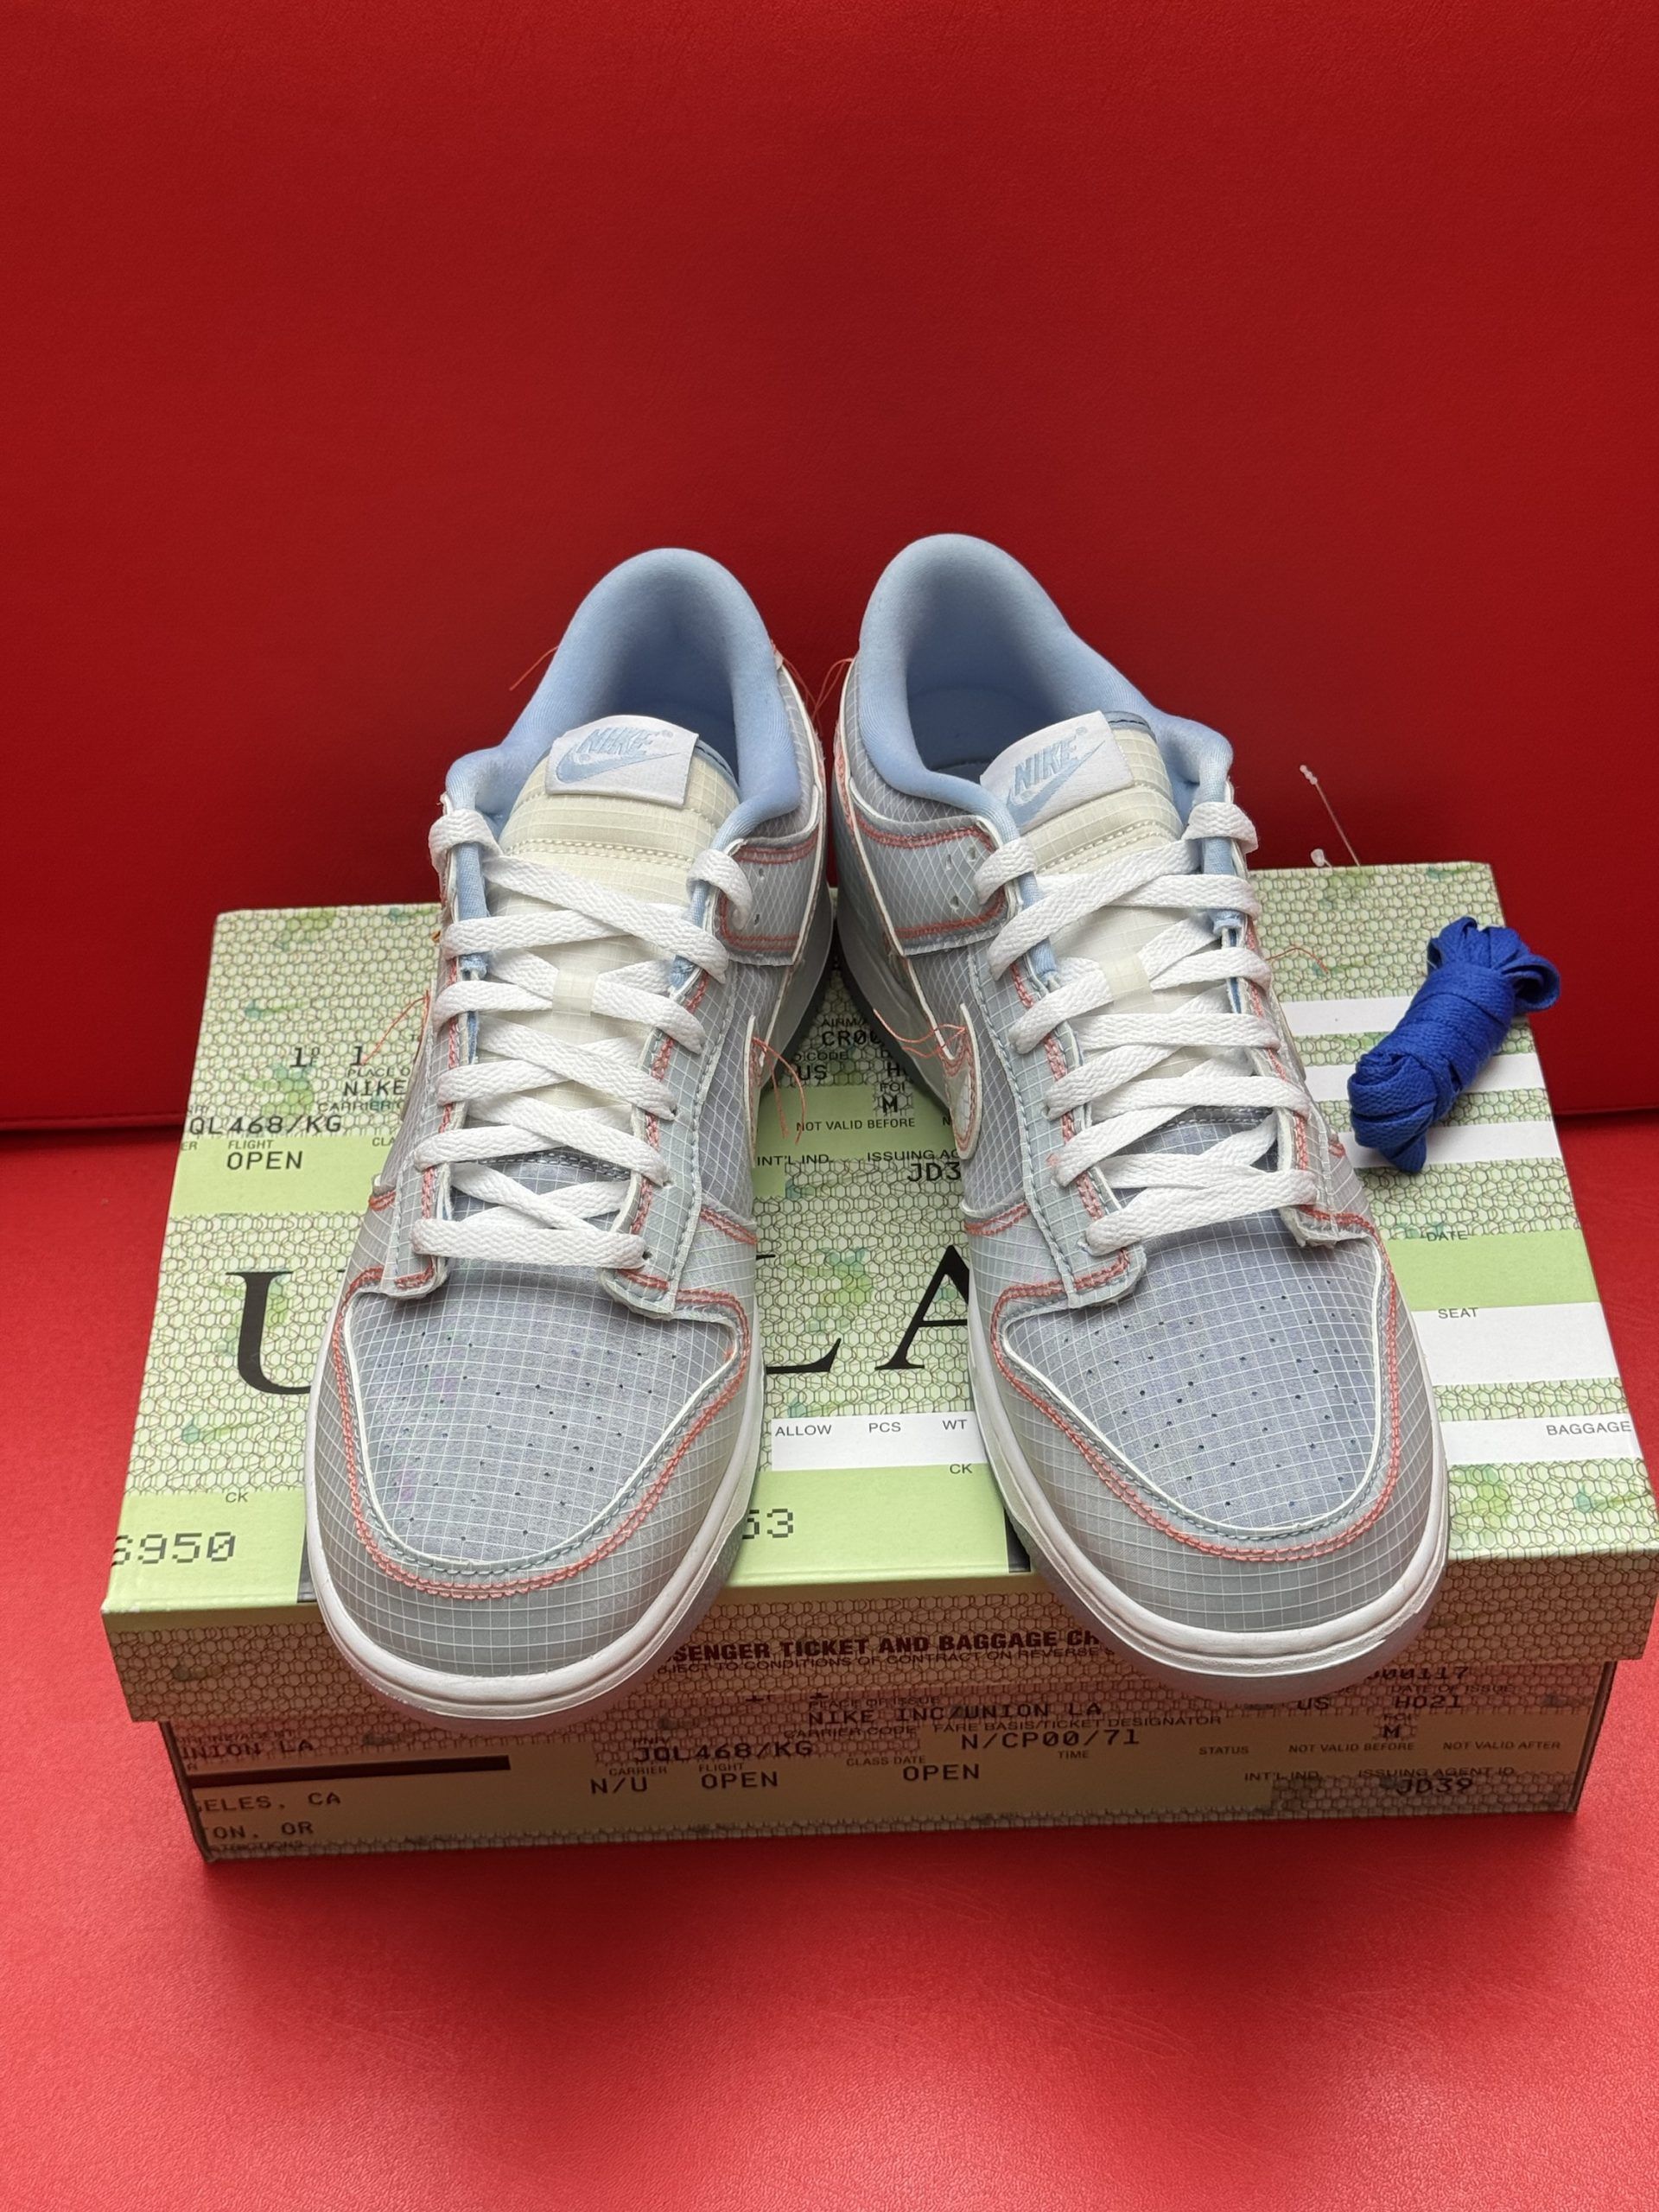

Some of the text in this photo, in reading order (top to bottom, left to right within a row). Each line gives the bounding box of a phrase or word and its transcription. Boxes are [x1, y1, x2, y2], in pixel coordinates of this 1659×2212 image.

[575, 727, 659, 754] NIKE
[1014, 734, 1077, 796] NIKE
[347, 1068, 396, 1077] PLACE
[798, 1065, 827, 1081] US
[345, 1079, 405, 1096] NIKE
[317, 1101, 391, 1112] CARRIER
[882, 1095, 898, 1113] M
[796, 1117, 916, 1131] NOT VALID BEFORE
[228, 1140, 273, 1149] FLIGHT
[226, 1150, 302, 1170] OPEN
[757, 1154, 796, 1166] INT'L
[867, 1149, 935, 1163] ISSUING
[1427, 1230, 1469, 1242] DATE
[1438, 1307, 1479, 1319] SEAT
[775, 1419, 968, 1437] ALLOW PCS WT
[1546, 1421, 1632, 1436] BAGGAGE
[950, 1463, 973, 1474] CK
[226, 1491, 249, 1503] CK
[779, 1637, 869, 1658] TICKET
[878, 1635, 931, 1654] AND
[939, 1630, 1058, 1651] BAGGAGE
[718, 1661, 741, 1672] TO
[744, 1656, 852, 1670] CONDITIONS
[857, 1655, 875, 1666] OF
[887, 1651, 981, 1665] CONTRACT
[987, 1649, 1014, 1661] ON
[1017, 1646, 1101, 1660] REVERSE
[1392, 1684, 1434, 1694] DATE
[1465, 1683, 1516, 1694] ISSUE
[808, 1699, 861, 1710] PLACE
[890, 1695, 942, 1707] ISSUE
[1295, 1696, 1331, 1711] US
[808, 1701, 1103, 1726] NIKE INC/UNION LA
[784, 1716, 1222, 1739] CARRIER CODE FARE BASIS/TICKET DESIGNATOR
[1382, 1724, 1402, 1738] M
[280, 1739, 314, 1753] LA
[634, 1739, 814, 1763] JQL468/KG
[609, 1740, 1561, 1777] CARRIER FLIGHT CLASS DATE TIME STATUS NOT VALID BEFORE NOT VALID AFTER
[589, 1764, 981, 1795] N/U OPEN OPEN
[1358, 1768, 1428, 1779] ISSUING
[1436, 1766, 1489, 1777] AGENT
[1498, 1766, 1516, 1777] ID
[1395, 1777, 1474, 1796] JD39
[308, 1791, 341, 1806] CA
[281, 1820, 315, 1835] OR
